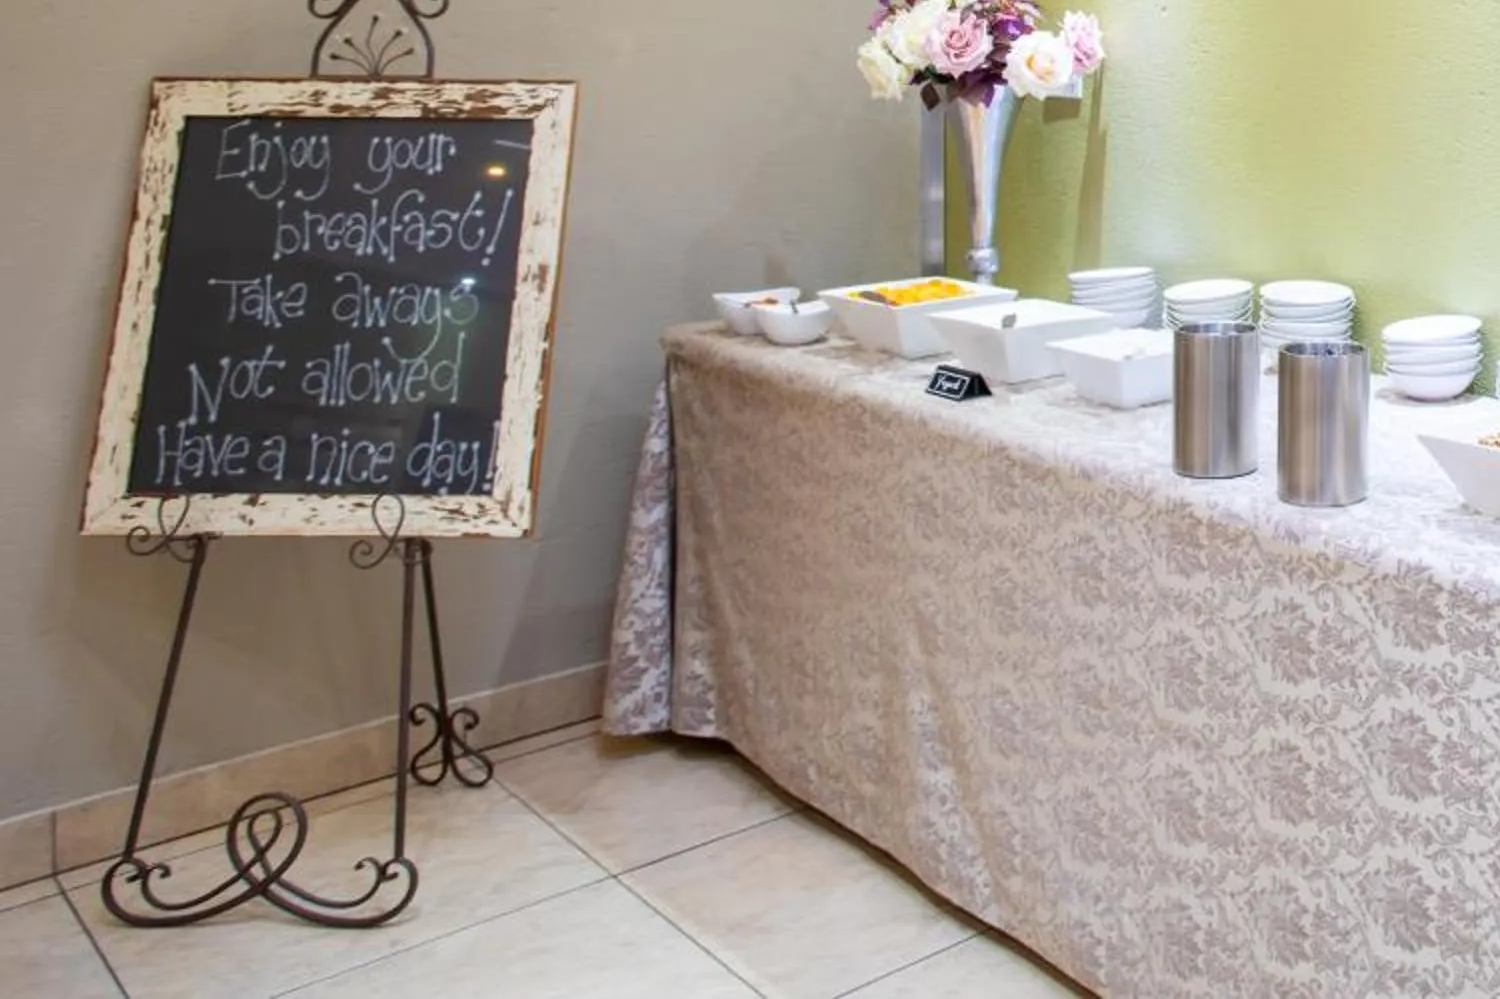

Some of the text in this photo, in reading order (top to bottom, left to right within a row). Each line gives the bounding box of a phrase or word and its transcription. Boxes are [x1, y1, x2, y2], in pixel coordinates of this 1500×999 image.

[215, 119, 457, 201] Enjoy your
[272, 188, 514, 267] breakfast!
[207, 271, 480, 364] Take aways
[187, 332, 466, 425] Not allowed
[155, 421, 250, 486] Have
[257, 436, 286, 481] a
[305, 428, 395, 486] nice
